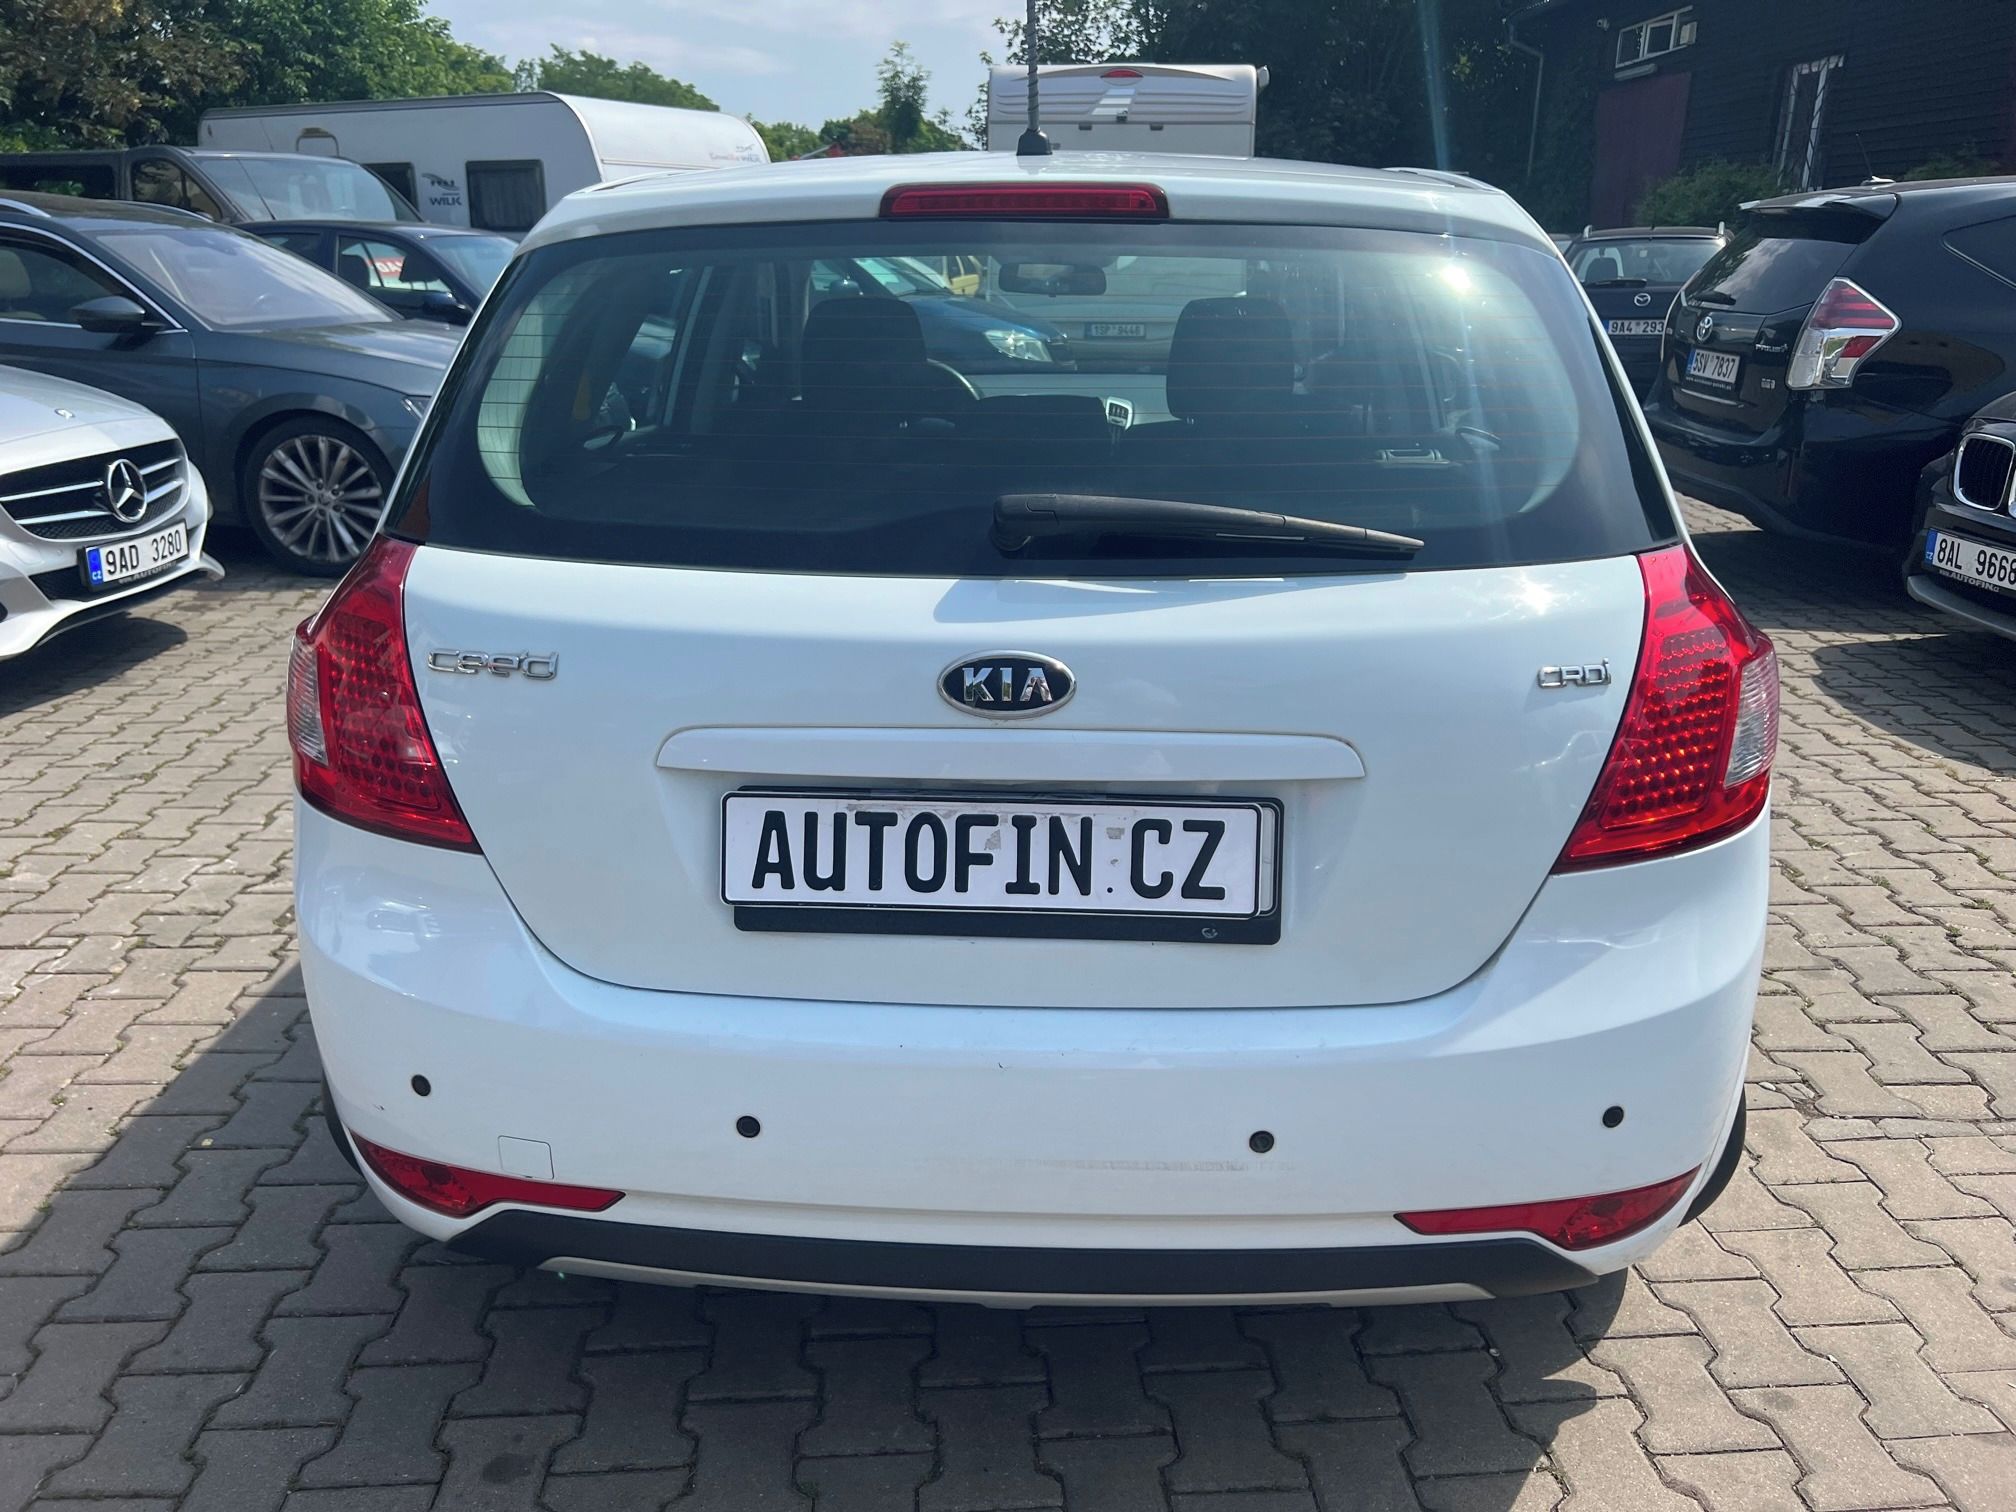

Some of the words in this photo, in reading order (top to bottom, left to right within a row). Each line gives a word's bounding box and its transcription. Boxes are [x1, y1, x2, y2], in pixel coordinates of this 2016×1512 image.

[429, 197, 462, 206] WILK
[1611, 321, 1633, 333] 9A4
[1642, 321, 1665, 333] 293
[1692, 352, 1709, 374] 5SV
[1711, 355, 1736, 379] 7837
[91, 570, 102, 580] CZ
[105, 544, 140, 576] 9AD
[151, 529, 182, 562] 3280
[1937, 538, 1963, 570] 8AL
[1975, 549, 2016, 586] 9668
[961, 667, 1053, 702] KIA
[1537, 657, 1611, 688] CRDi
[751, 810, 1226, 901] AUTOFIN.CZ
